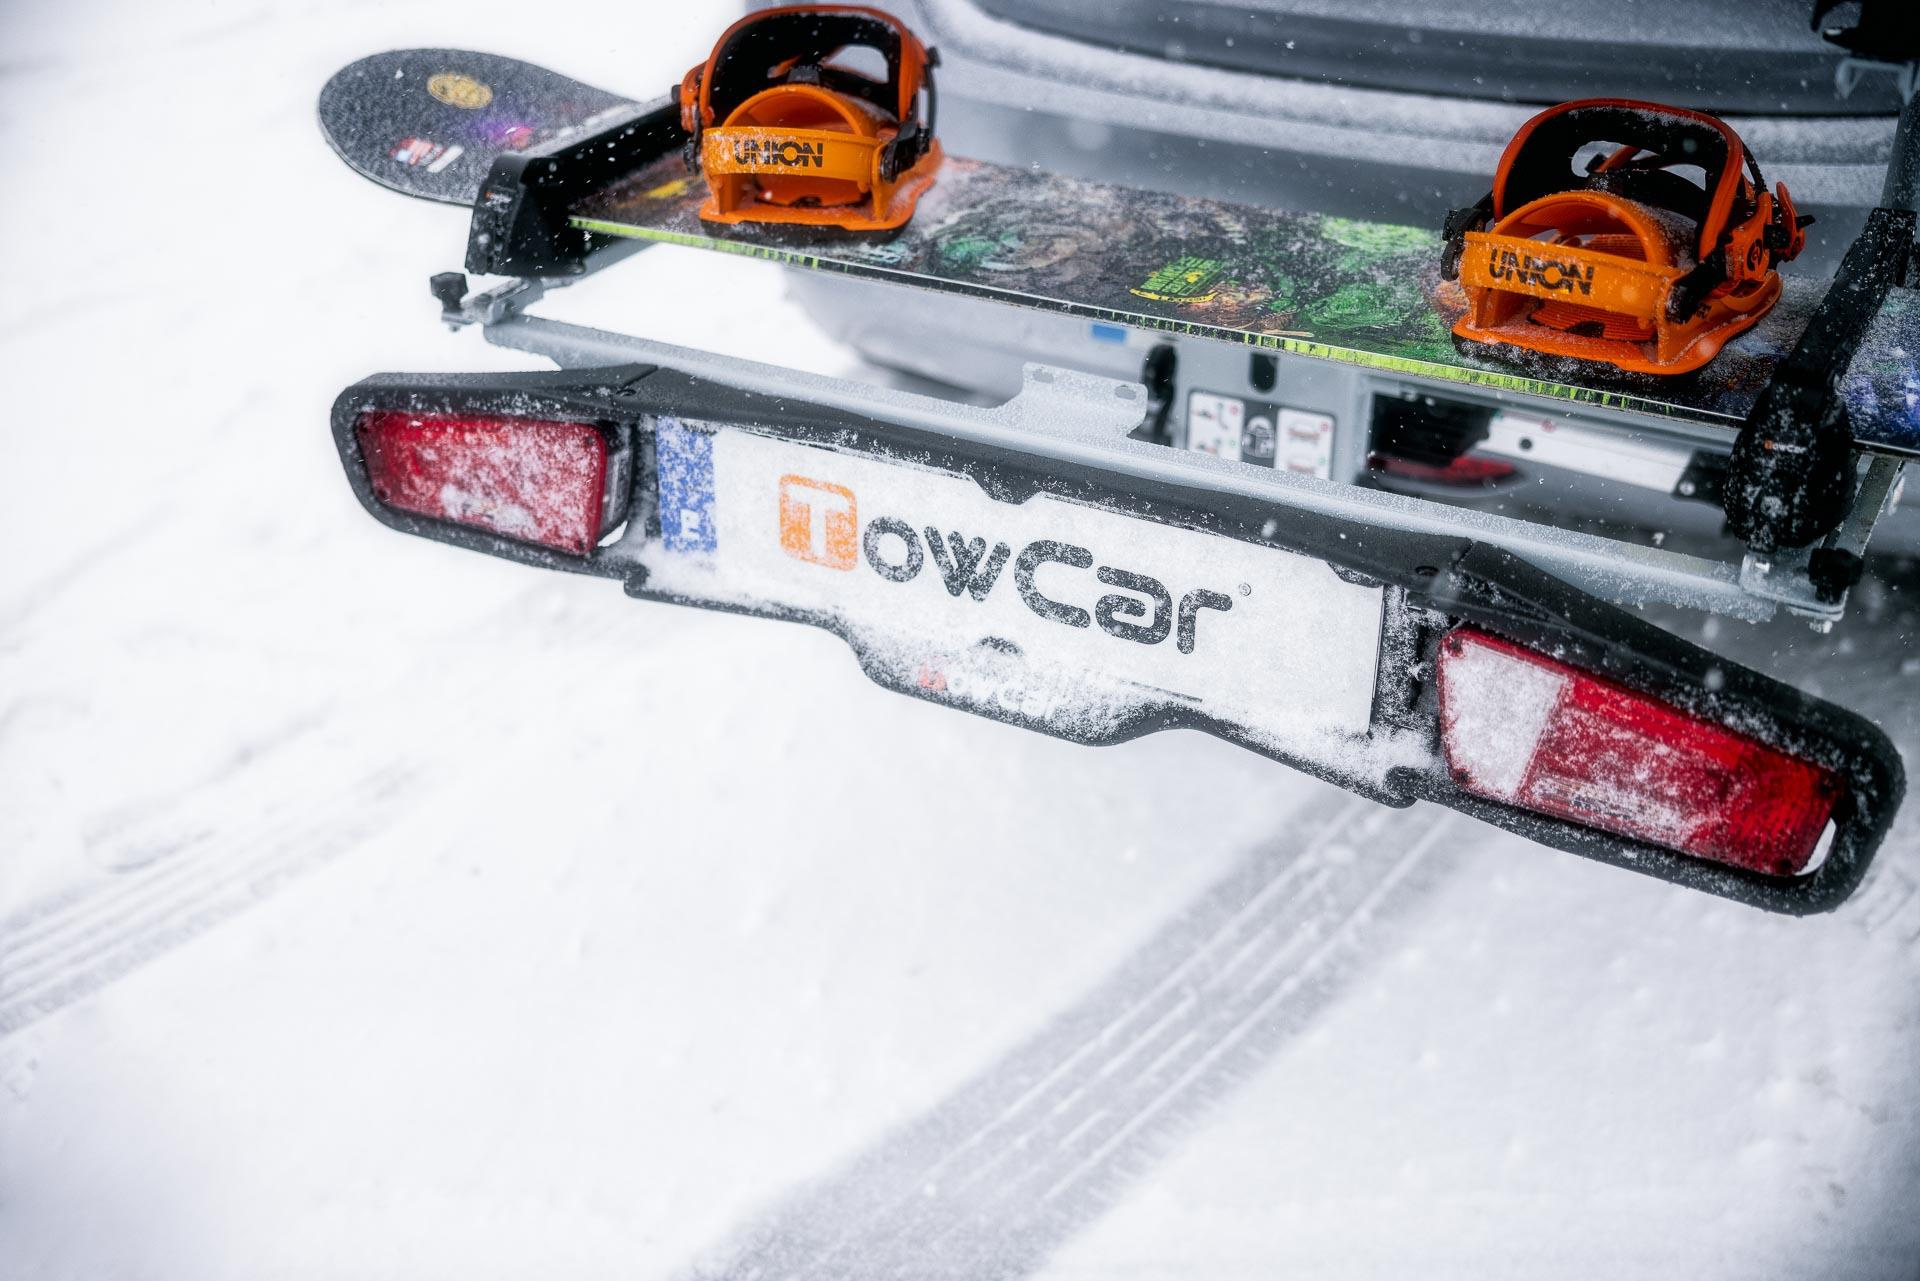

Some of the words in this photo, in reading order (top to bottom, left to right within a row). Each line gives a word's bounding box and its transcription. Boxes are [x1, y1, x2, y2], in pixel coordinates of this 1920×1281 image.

[734, 140, 823, 168] UNION
[1490, 249, 1594, 295] UNION
[780, 473, 1234, 655] TowCar
